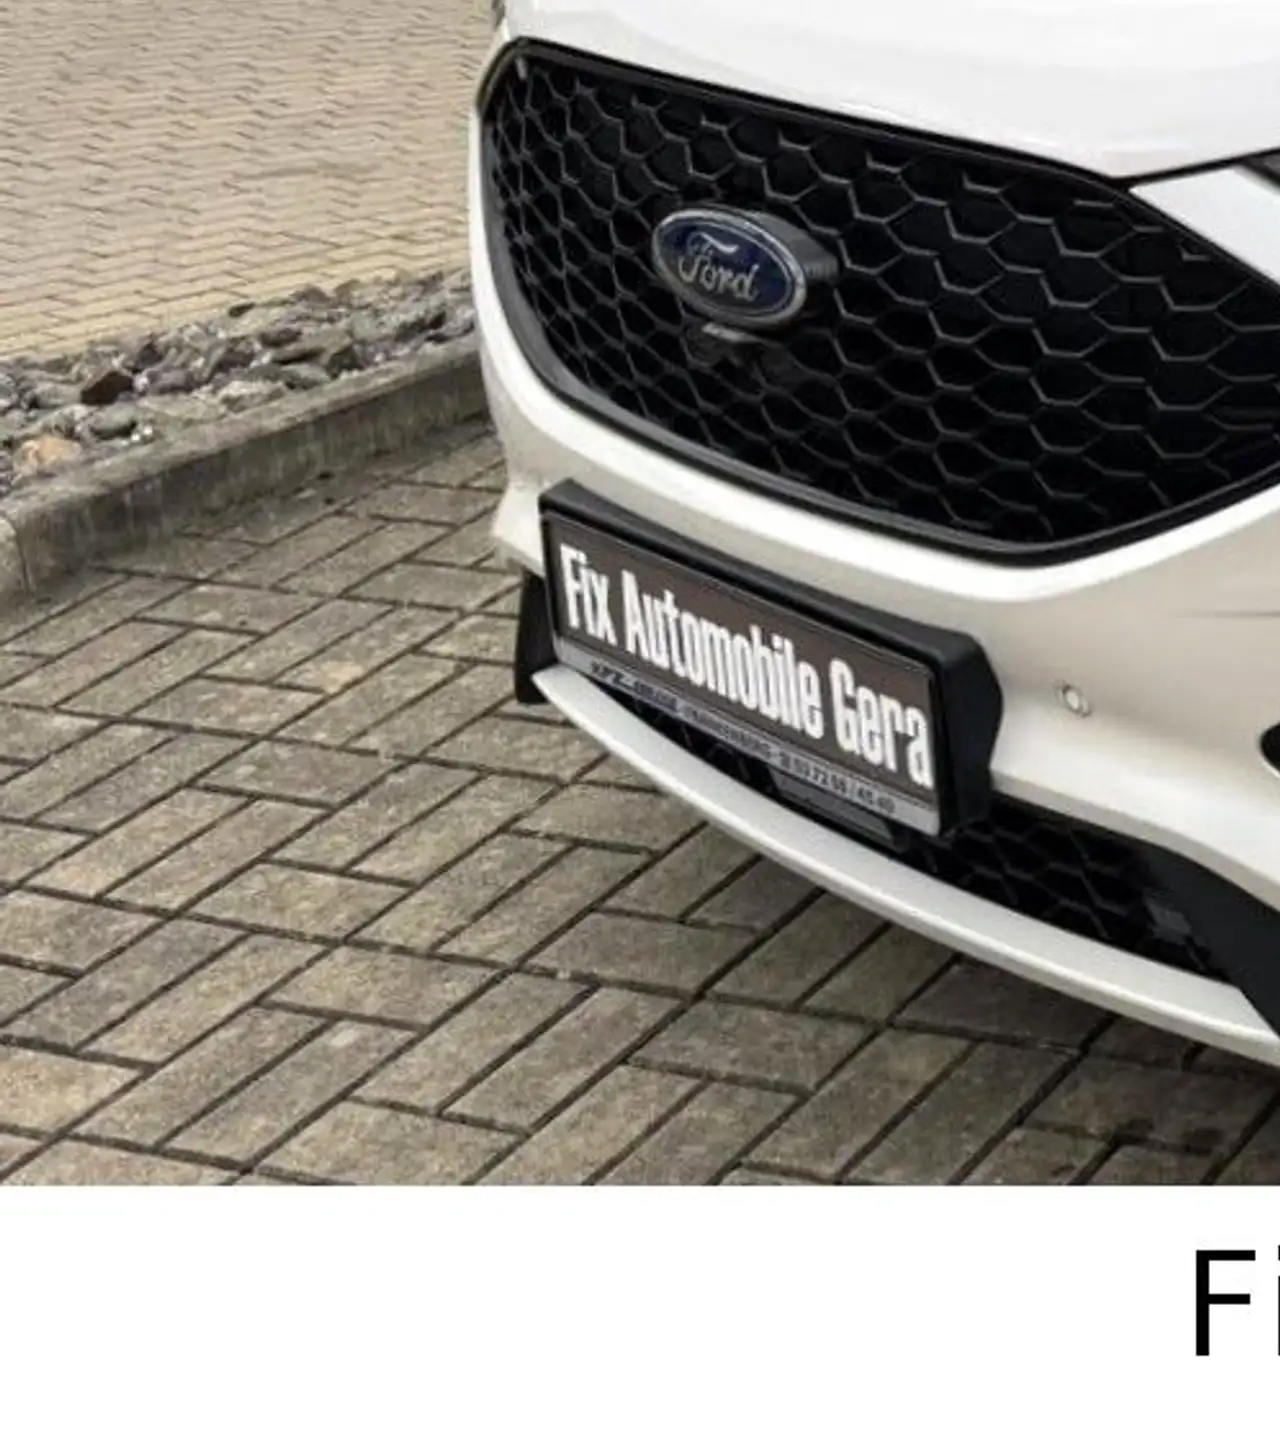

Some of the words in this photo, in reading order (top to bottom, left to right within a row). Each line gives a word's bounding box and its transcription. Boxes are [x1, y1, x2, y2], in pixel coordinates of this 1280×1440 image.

[678, 231, 760, 302] Ford
[560, 542, 618, 648] Fix
[621, 568, 825, 741] Automobile
[829, 656, 934, 791] Gera
